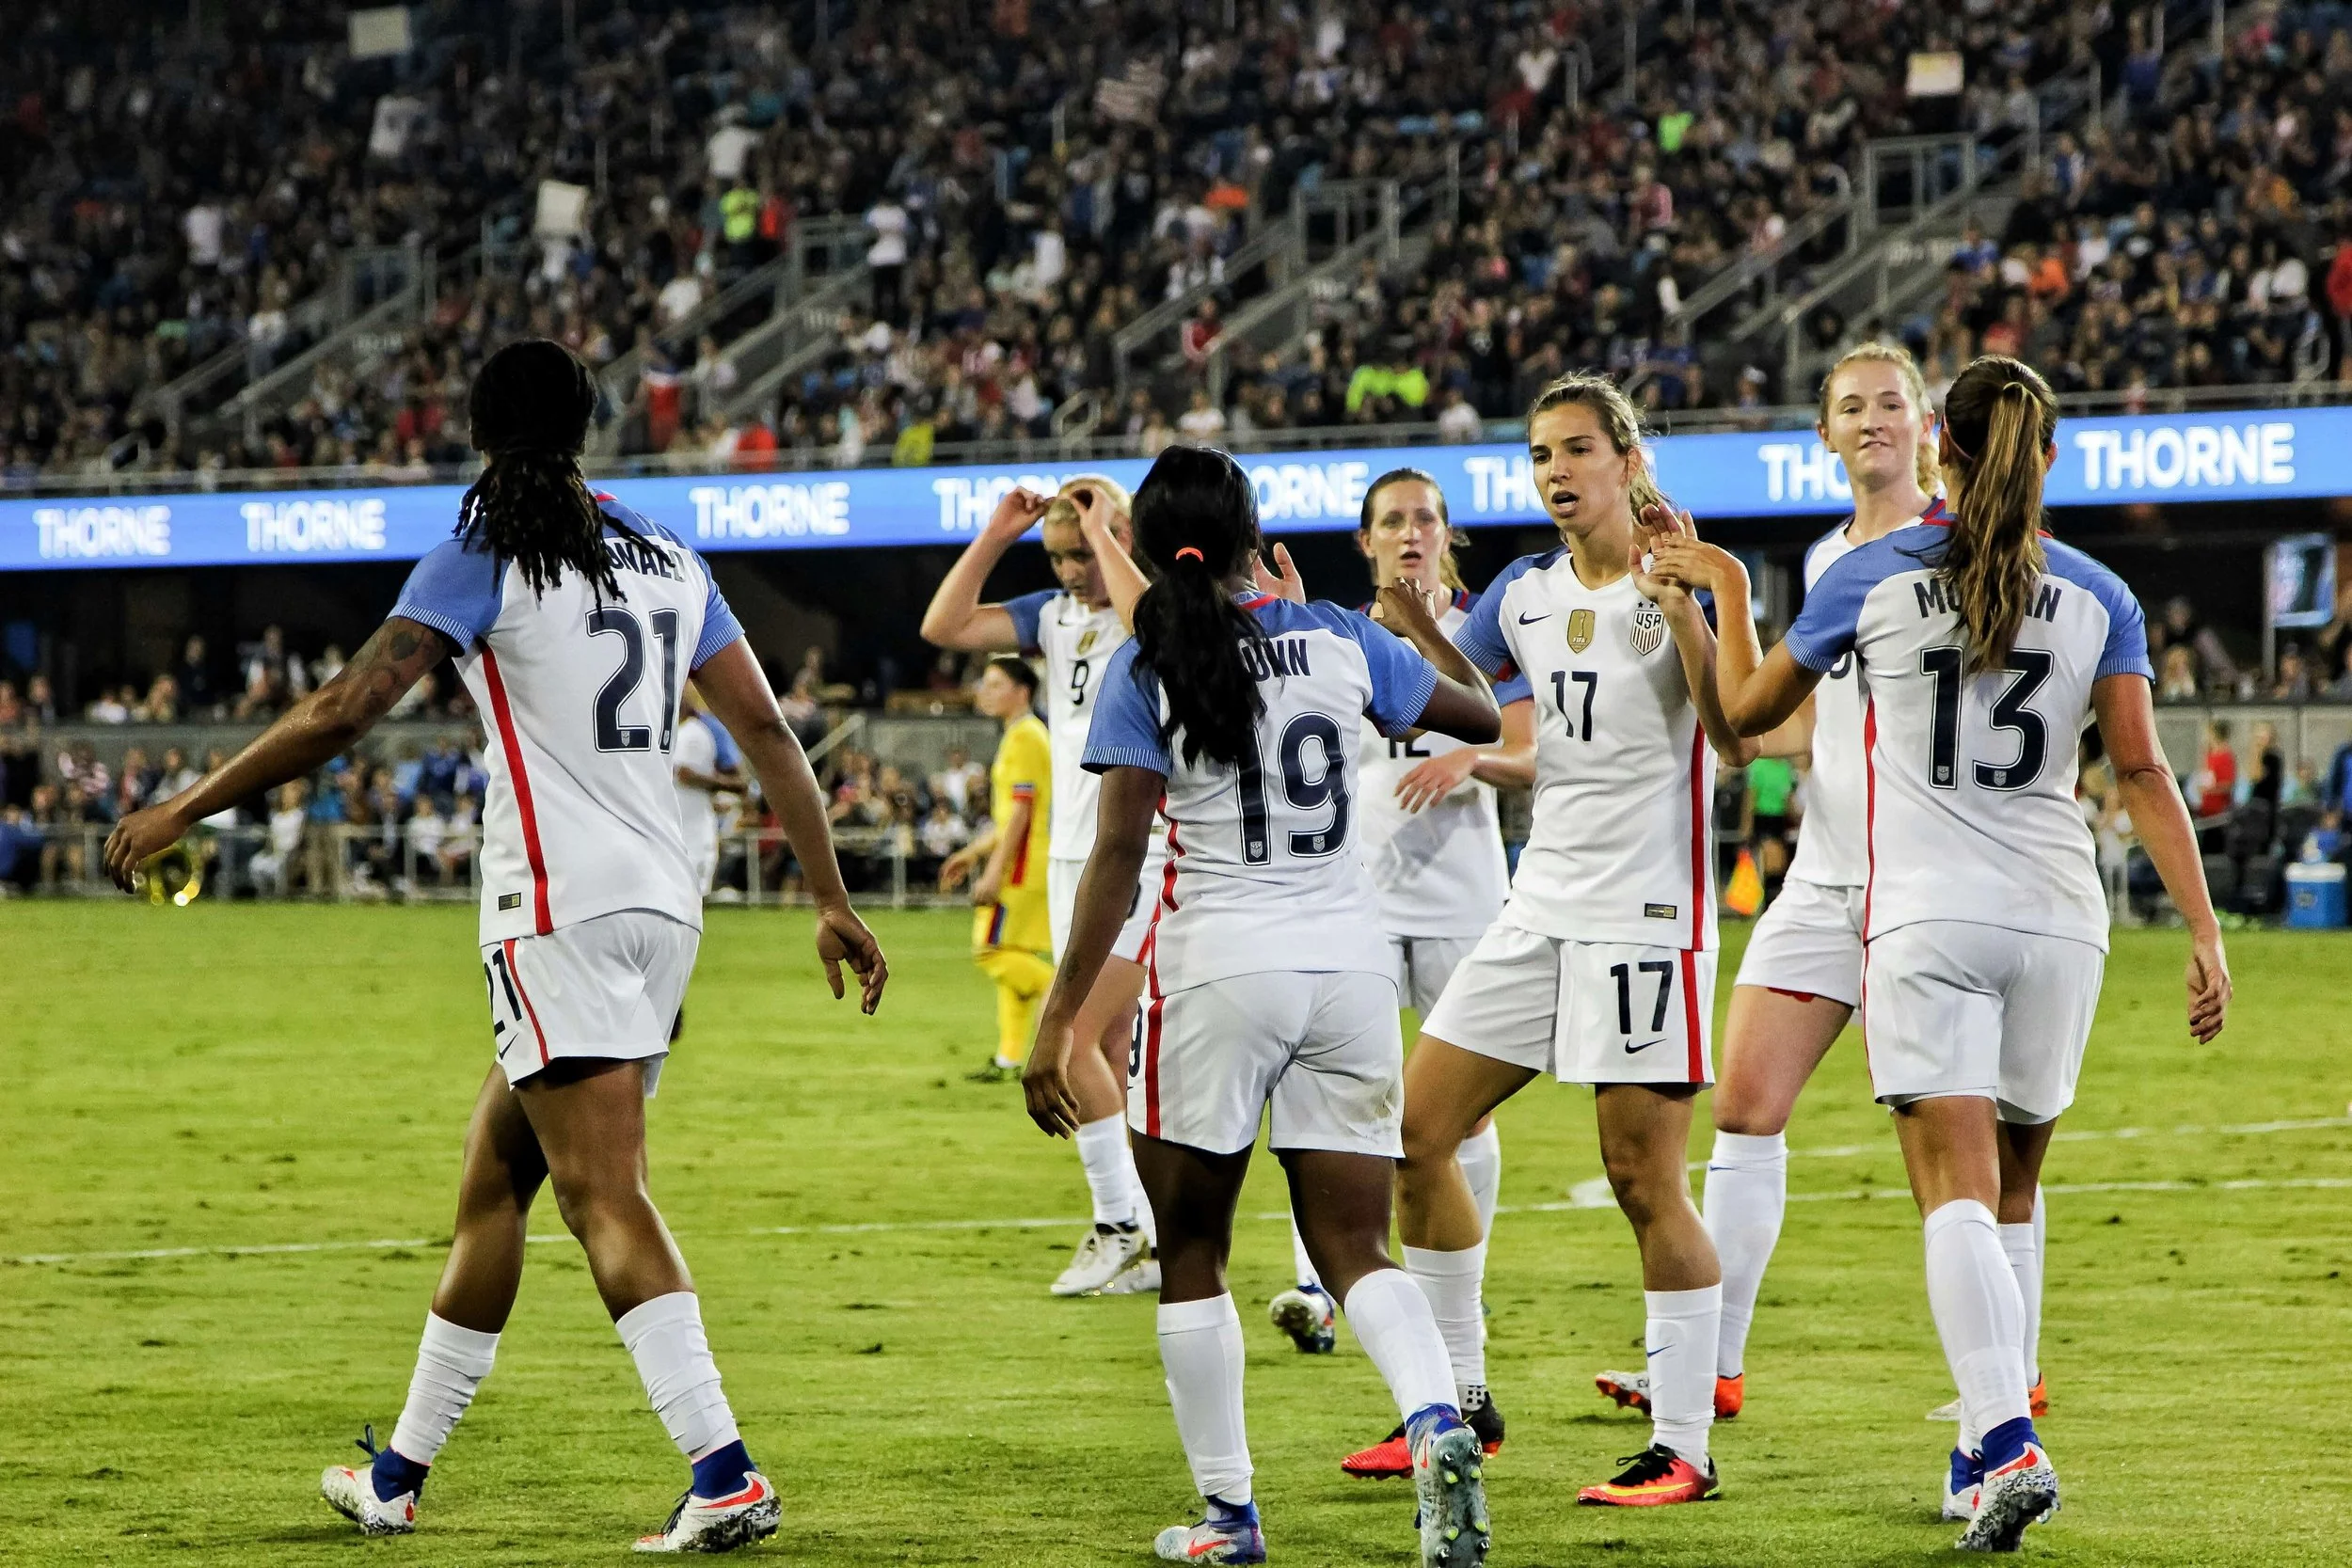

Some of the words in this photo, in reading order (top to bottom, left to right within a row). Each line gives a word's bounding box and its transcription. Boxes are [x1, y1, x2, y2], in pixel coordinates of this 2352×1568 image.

[2074, 422, 2296, 490] THORNE
[689, 483, 850, 539] THORNE
[1248, 461, 1369, 520] ORNE
[32, 505, 172, 559] THORNE
[240, 499, 386, 552] THORNE
[1636, 612, 1661, 629] USA
[585, 607, 680, 754] 21
[1072, 659, 1089, 705] 9
[1242, 639, 1311, 682] UNN
[1550, 671, 1597, 742] 17
[1920, 645, 2055, 791] 13
[1232, 711, 1351, 866] 19
[1610, 960, 1674, 1035] 17
